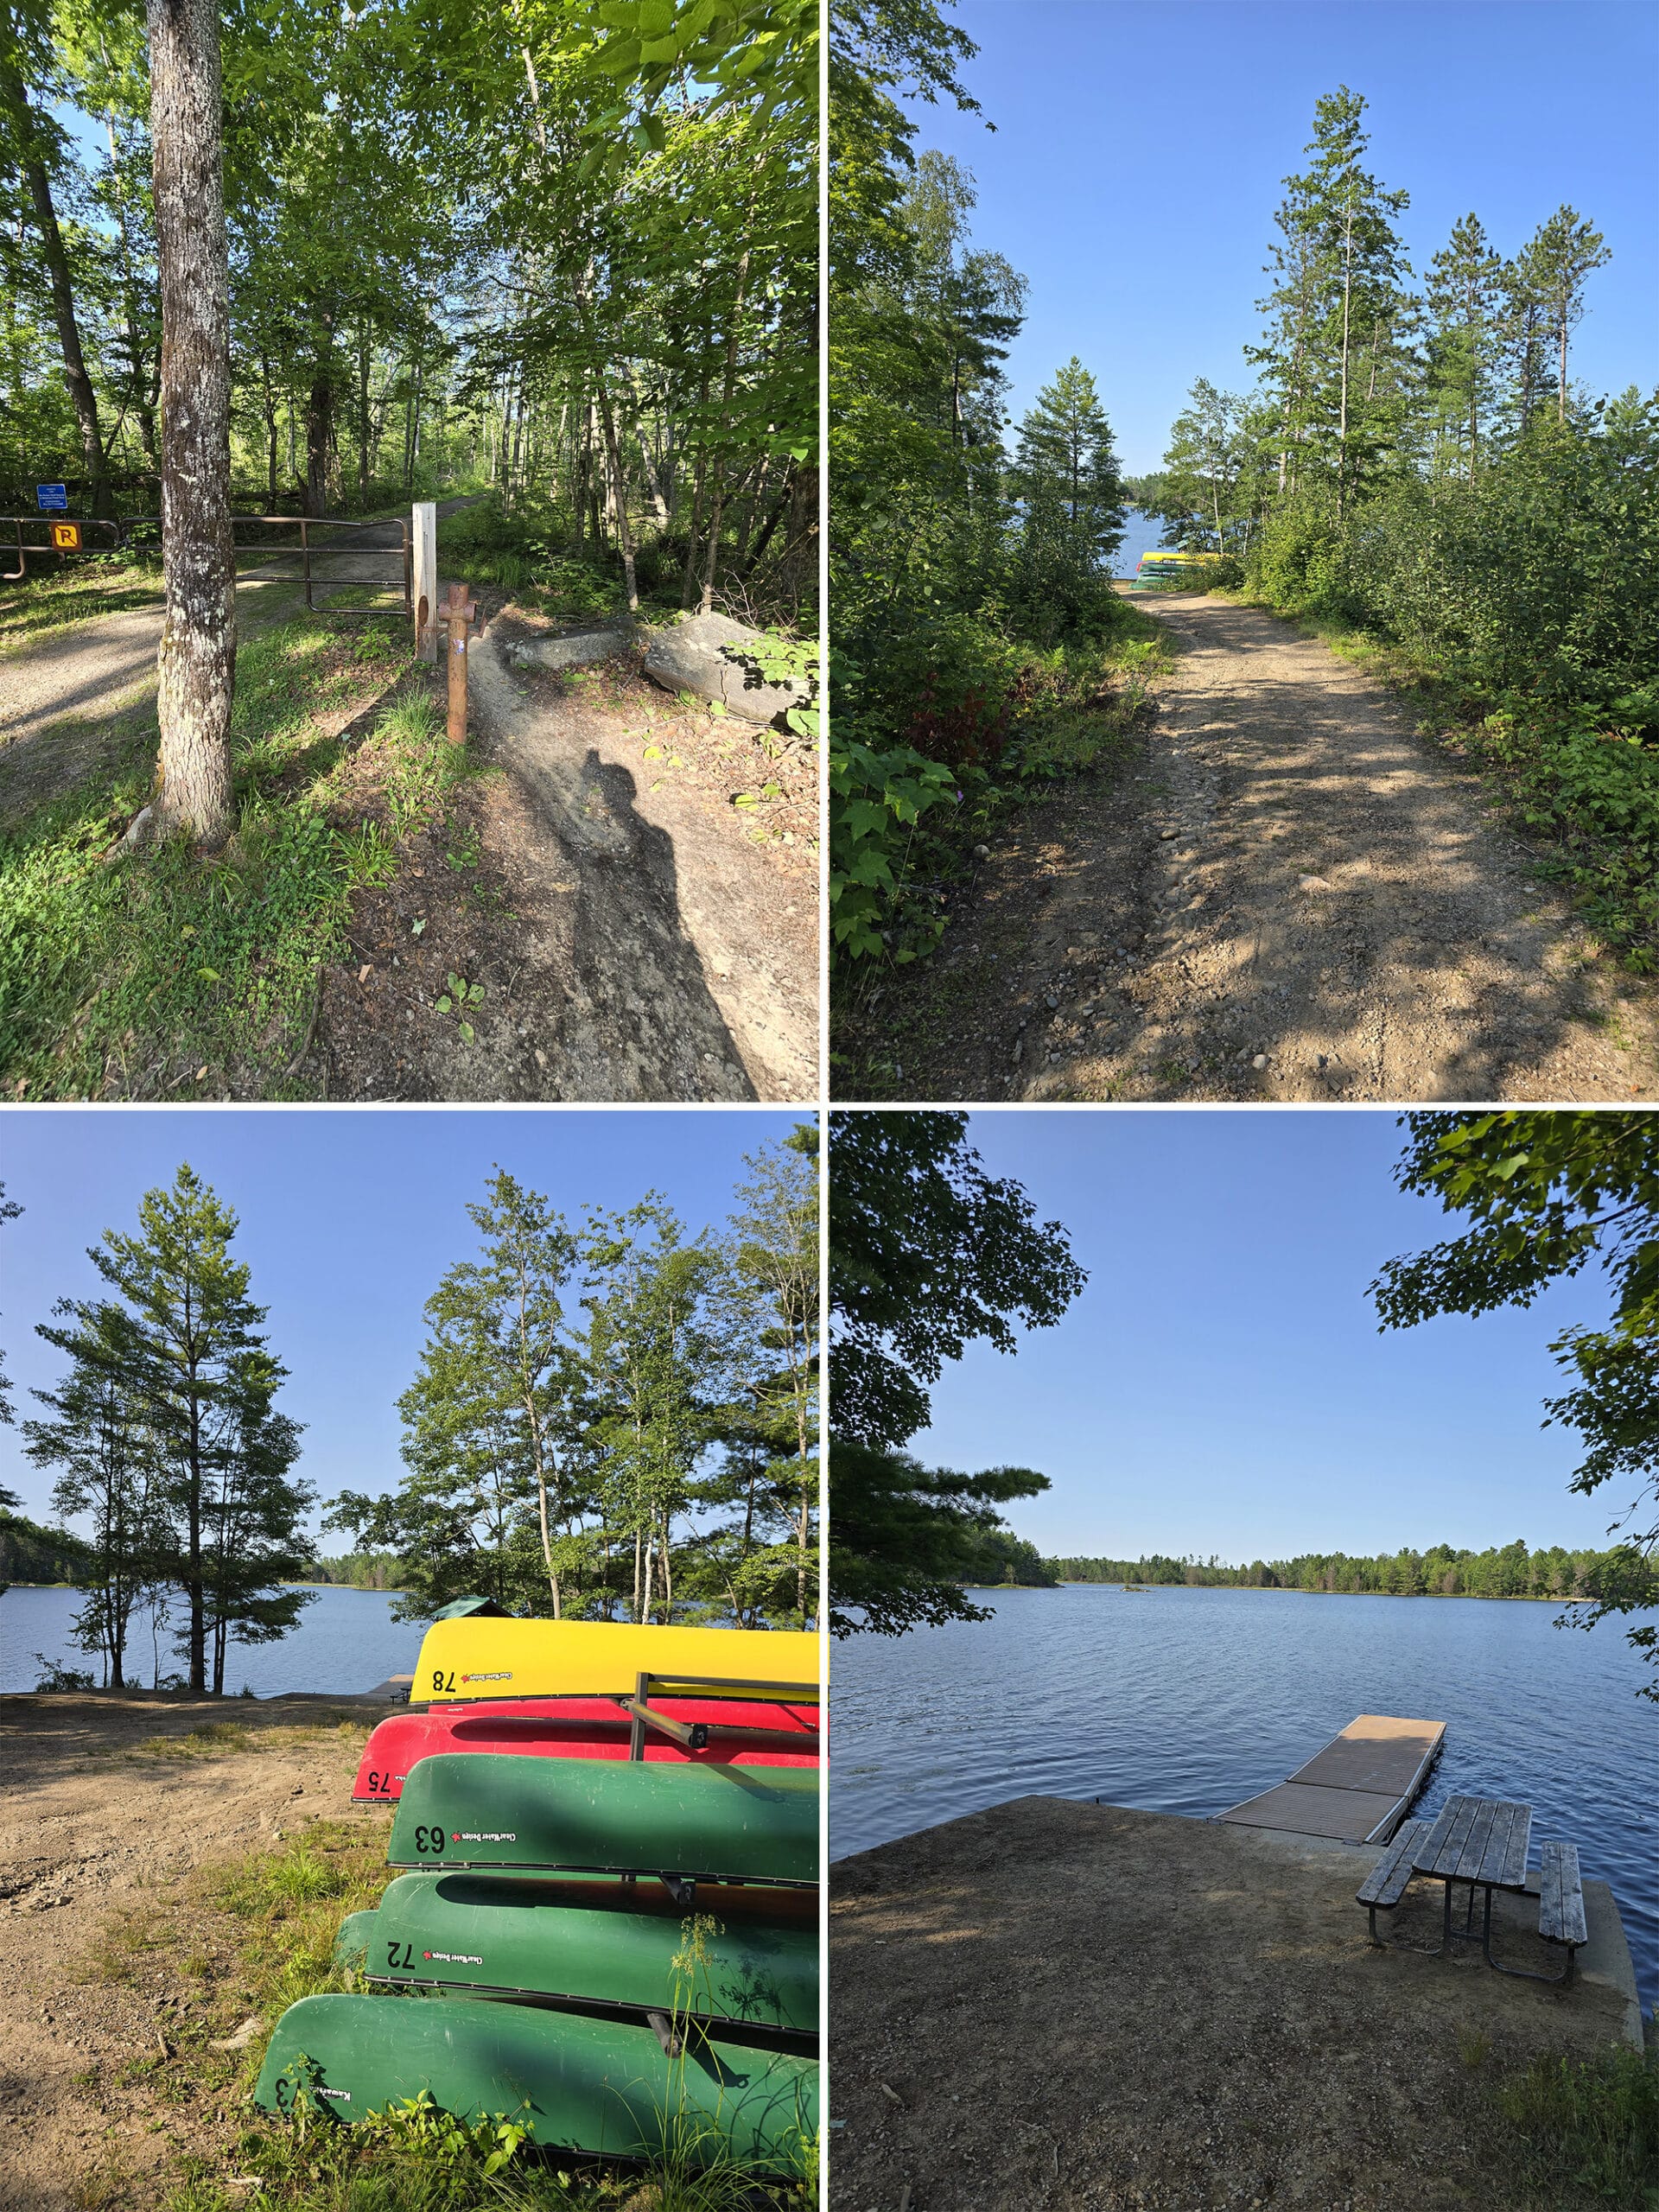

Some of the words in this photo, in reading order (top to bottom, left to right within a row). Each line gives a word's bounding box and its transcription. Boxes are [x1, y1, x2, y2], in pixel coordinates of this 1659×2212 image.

[432, 1670, 456, 1693] 78
[469, 1673, 486, 1681] Design
[368, 1771, 391, 1793] 75
[415, 1826, 445, 1854] 63
[461, 1832, 481, 1841] Design
[482, 1833, 517, 1843] ClearWater
[387, 1942, 415, 1970] 72
[432, 1951, 451, 1963] Design
[451, 1952, 484, 1966] ClearWater
